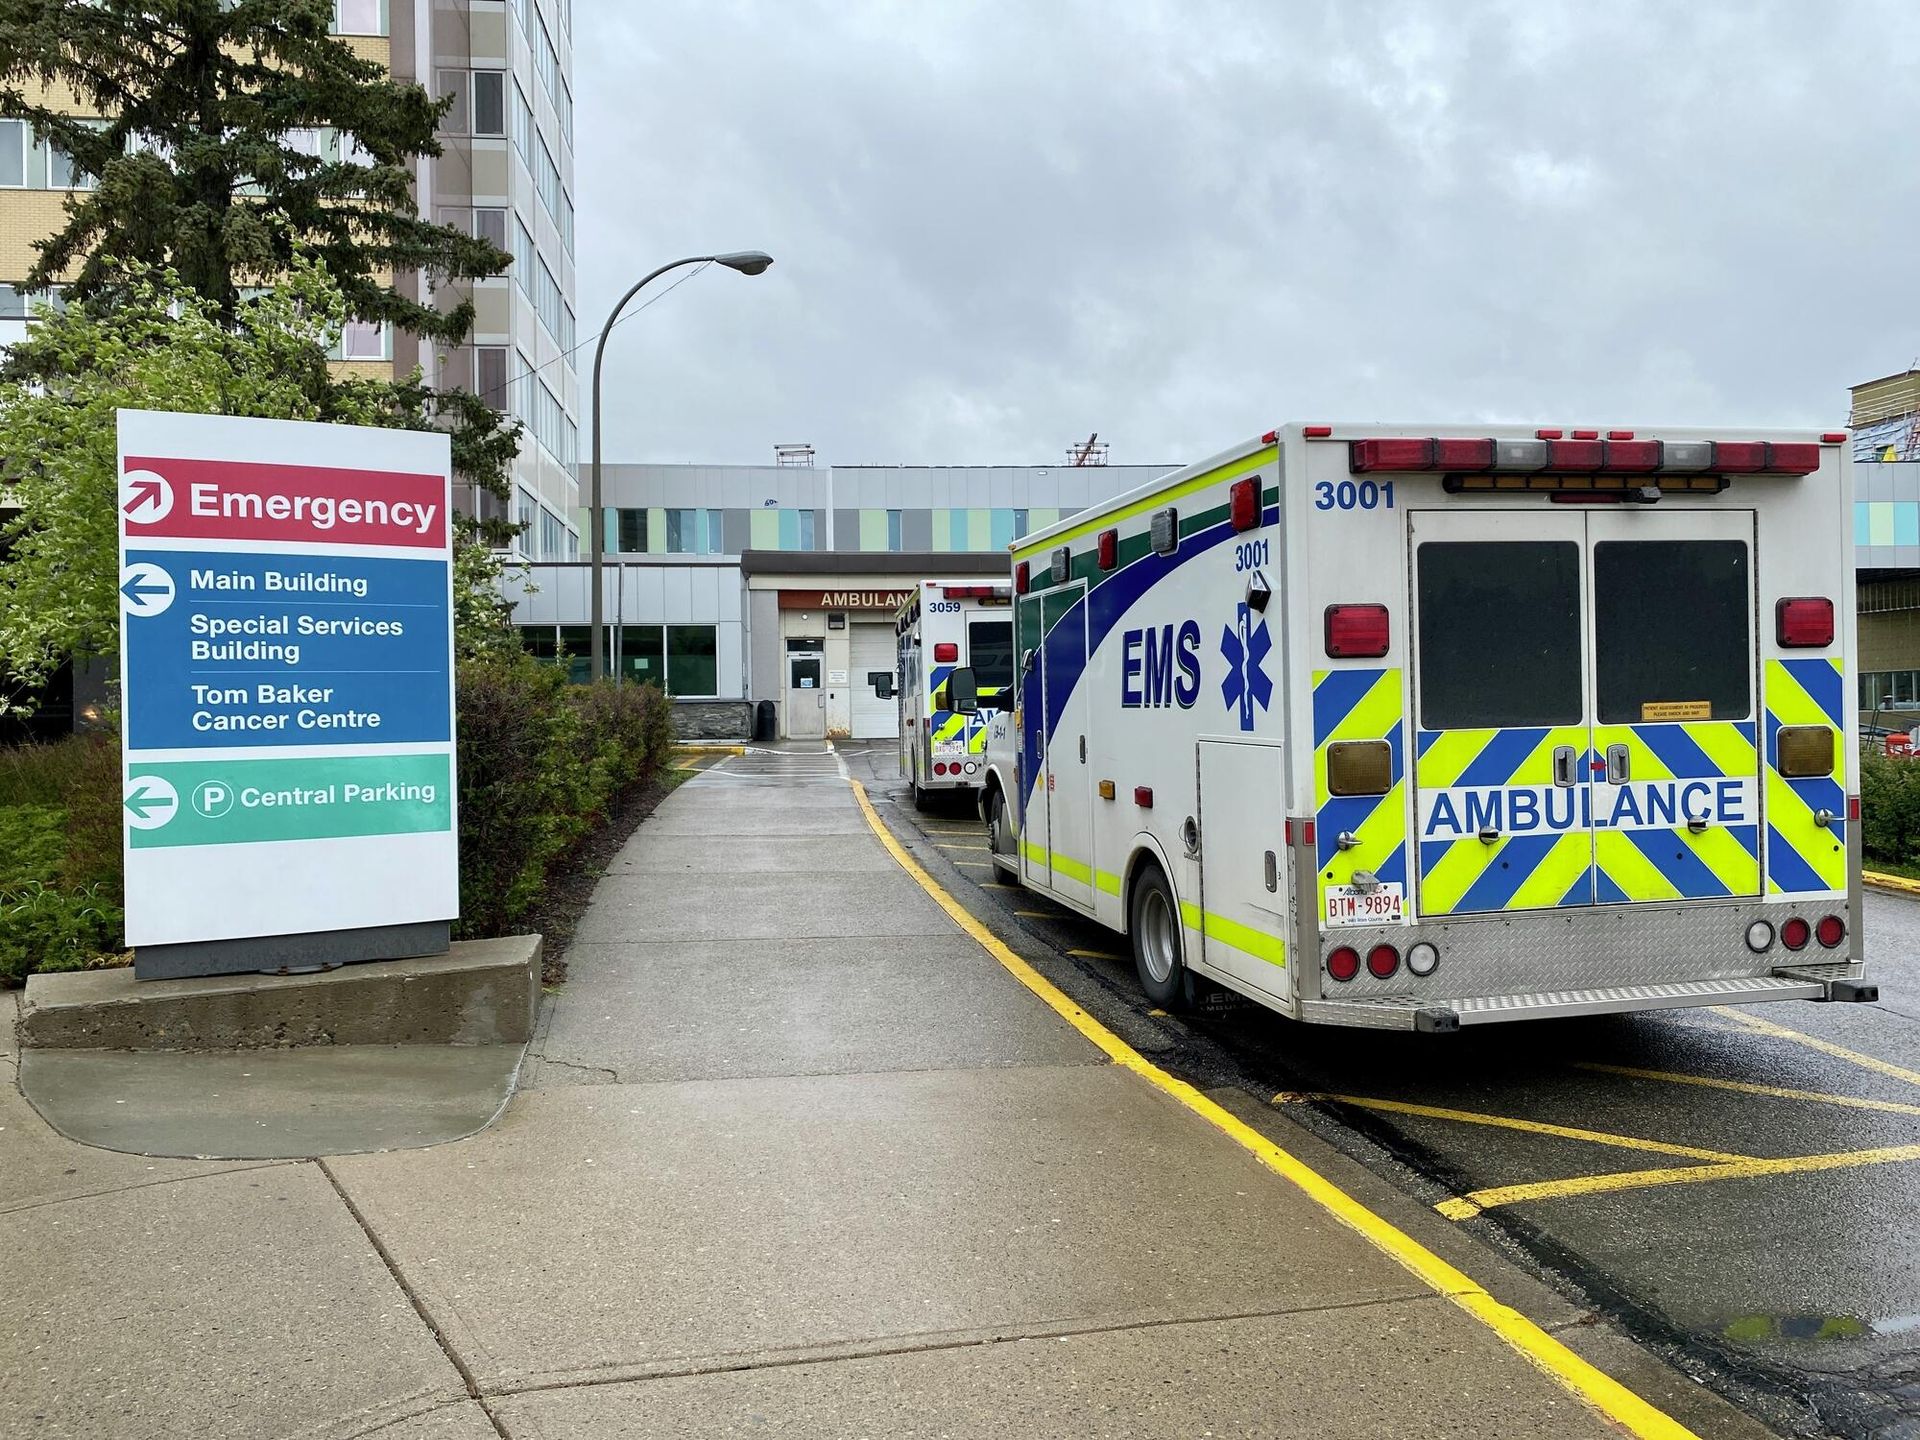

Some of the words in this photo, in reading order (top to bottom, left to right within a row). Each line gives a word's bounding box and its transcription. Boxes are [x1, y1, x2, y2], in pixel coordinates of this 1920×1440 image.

[1315, 481, 1394, 510] 3001
[191, 483, 436, 534] Emergency
[1235, 538, 1269, 572] 3001
[190, 569, 256, 591] Main
[264, 571, 368, 597] Building
[929, 602, 961, 613] 3059
[190, 614, 289, 638] Special
[297, 615, 404, 636] Services
[191, 640, 300, 664] Building
[1121, 619, 1201, 710] EMS
[191, 684, 248, 705] Tom
[258, 684, 334, 704] Baker
[192, 711, 289, 731] Cancer
[296, 709, 381, 729] Centre
[240, 785, 335, 807] Central
[344, 782, 436, 804] Parking
[1425, 781, 1745, 836] AMBULANCE
[1329, 895, 1401, 917] BTM-9894
